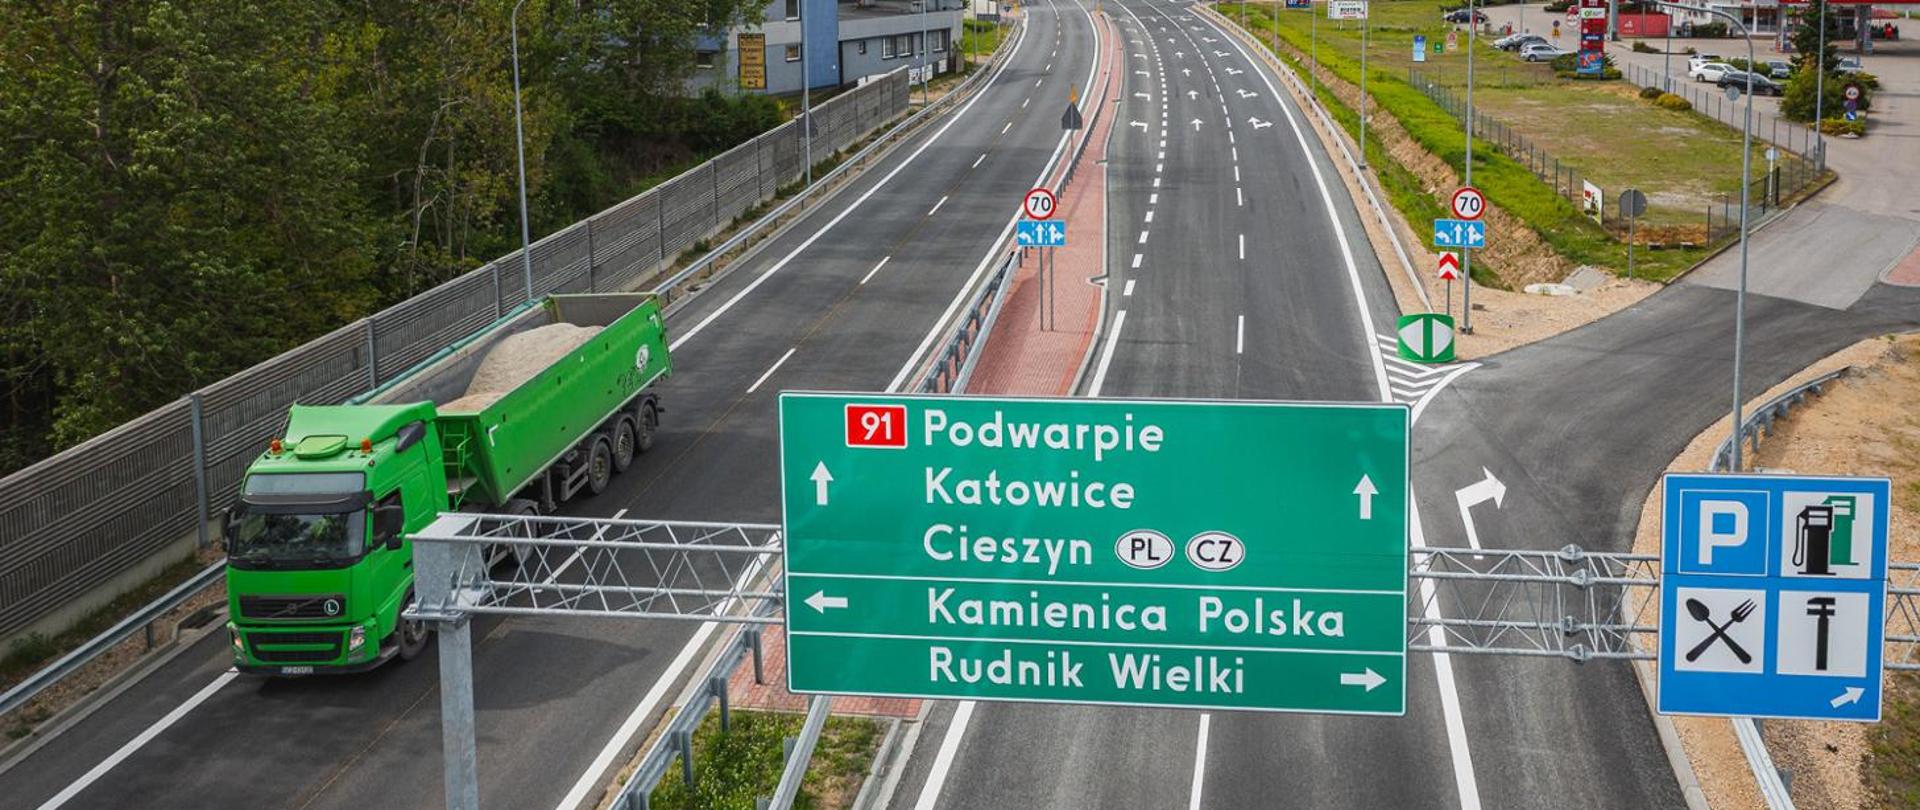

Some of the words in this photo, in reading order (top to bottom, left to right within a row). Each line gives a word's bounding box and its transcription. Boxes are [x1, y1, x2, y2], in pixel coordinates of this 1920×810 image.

[1031, 196, 1051, 212] 70
[1460, 196, 1480, 212] 70
[860, 411, 892, 440] 91
[924, 409, 1164, 461] Podwarpie
[926, 467, 1135, 509] Katowice
[923, 524, 1092, 575] Cieszyn
[1131, 538, 1160, 560] PL
[1196, 540, 1232, 562] CZ
[1698, 500, 1749, 565] P
[928, 587, 1167, 632] Kamienica
[1199, 596, 1344, 638] Polska
[930, 646, 1083, 688] Rudnik
[1108, 653, 1243, 693] Wielki
